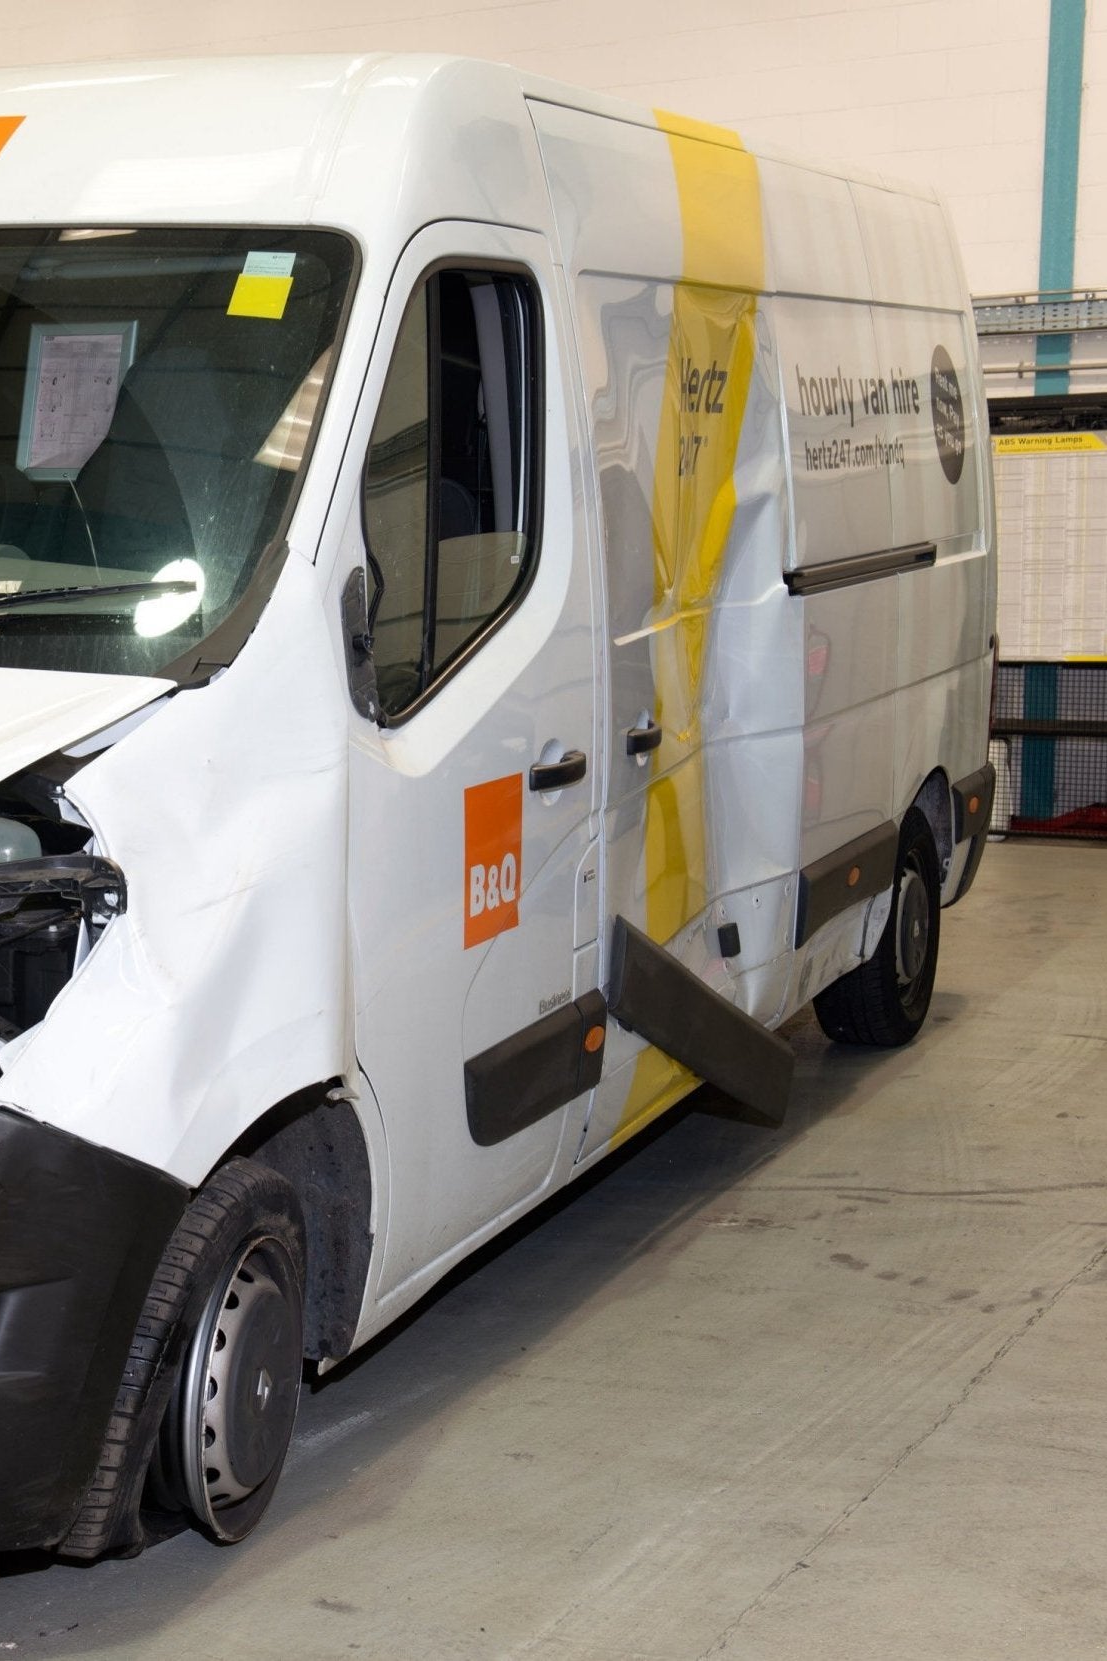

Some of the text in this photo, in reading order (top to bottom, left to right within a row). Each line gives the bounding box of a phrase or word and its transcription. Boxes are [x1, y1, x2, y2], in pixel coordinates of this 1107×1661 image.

[680, 357, 728, 414] Hertz
[796, 364, 920, 427] hourly van hire
[805, 434, 905, 471] hertz247.com/bandq
[998, 436, 1083, 446] ABS Warning Lamps
[469, 852, 516, 918] B&Q
